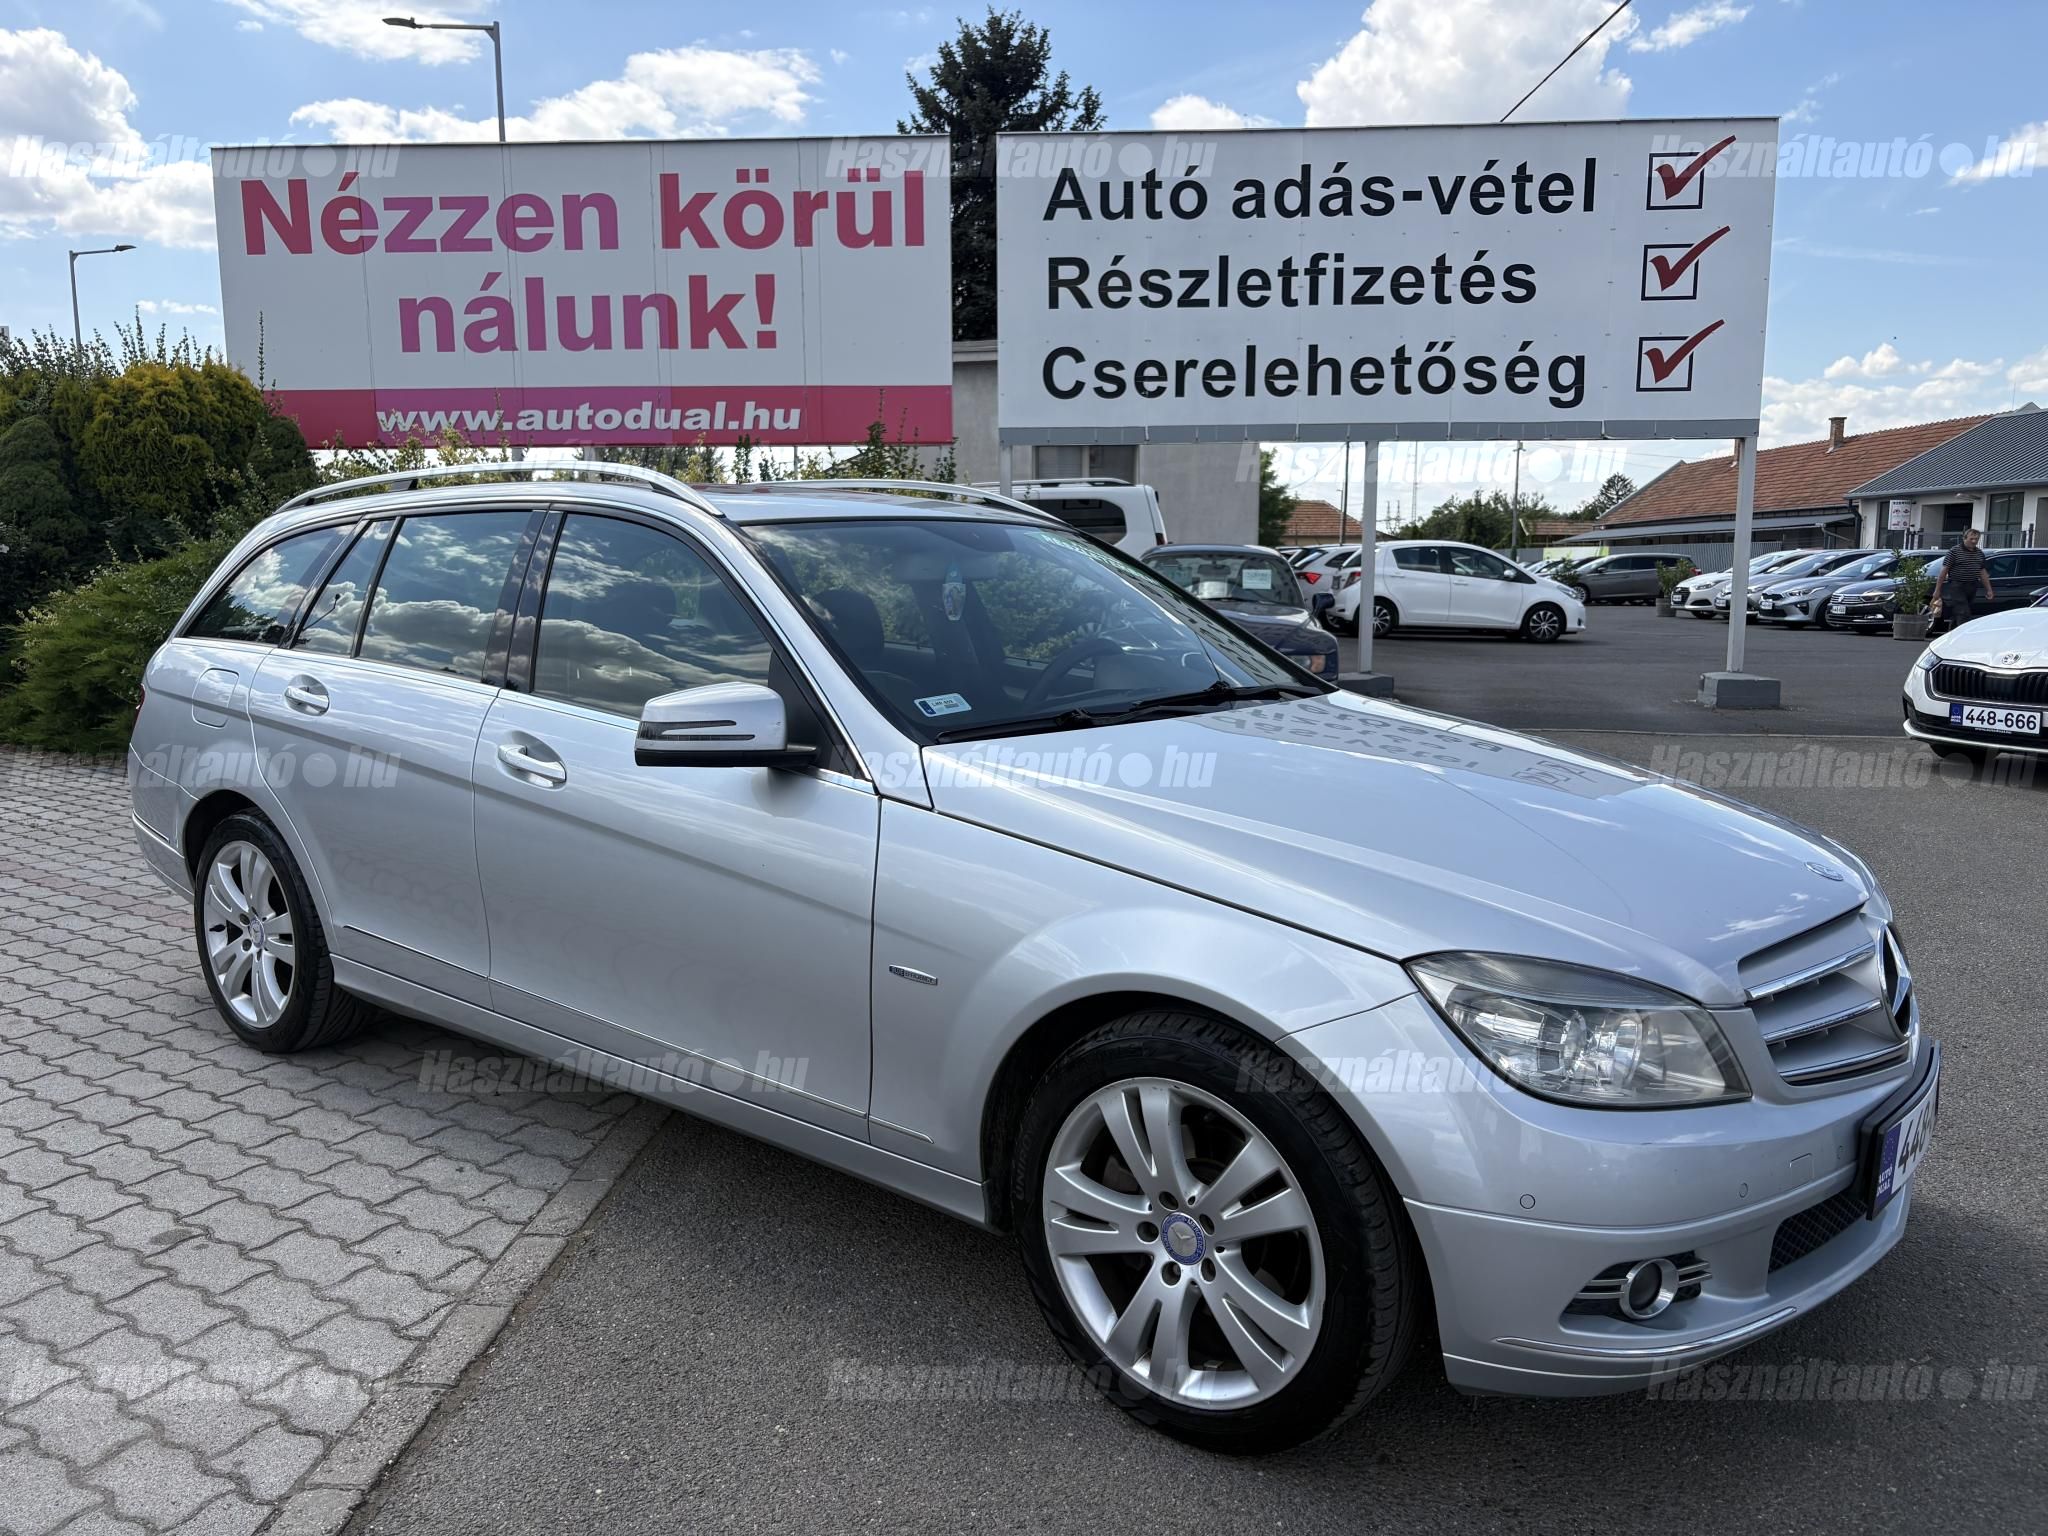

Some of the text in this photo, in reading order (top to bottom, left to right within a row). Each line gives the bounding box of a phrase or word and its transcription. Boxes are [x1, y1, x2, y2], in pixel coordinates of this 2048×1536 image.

[241, 168, 925, 255] Nézzen körül
[1042, 157, 1597, 222] Autó adás-vétel
[398, 271, 777, 353] nálunk!
[1047, 249, 1538, 310] Részletfizetés
[1042, 340, 1586, 409] Cserelehetőség
[376, 401, 801, 432] www.autodual.hu
[1965, 708, 2038, 731] 448-666
